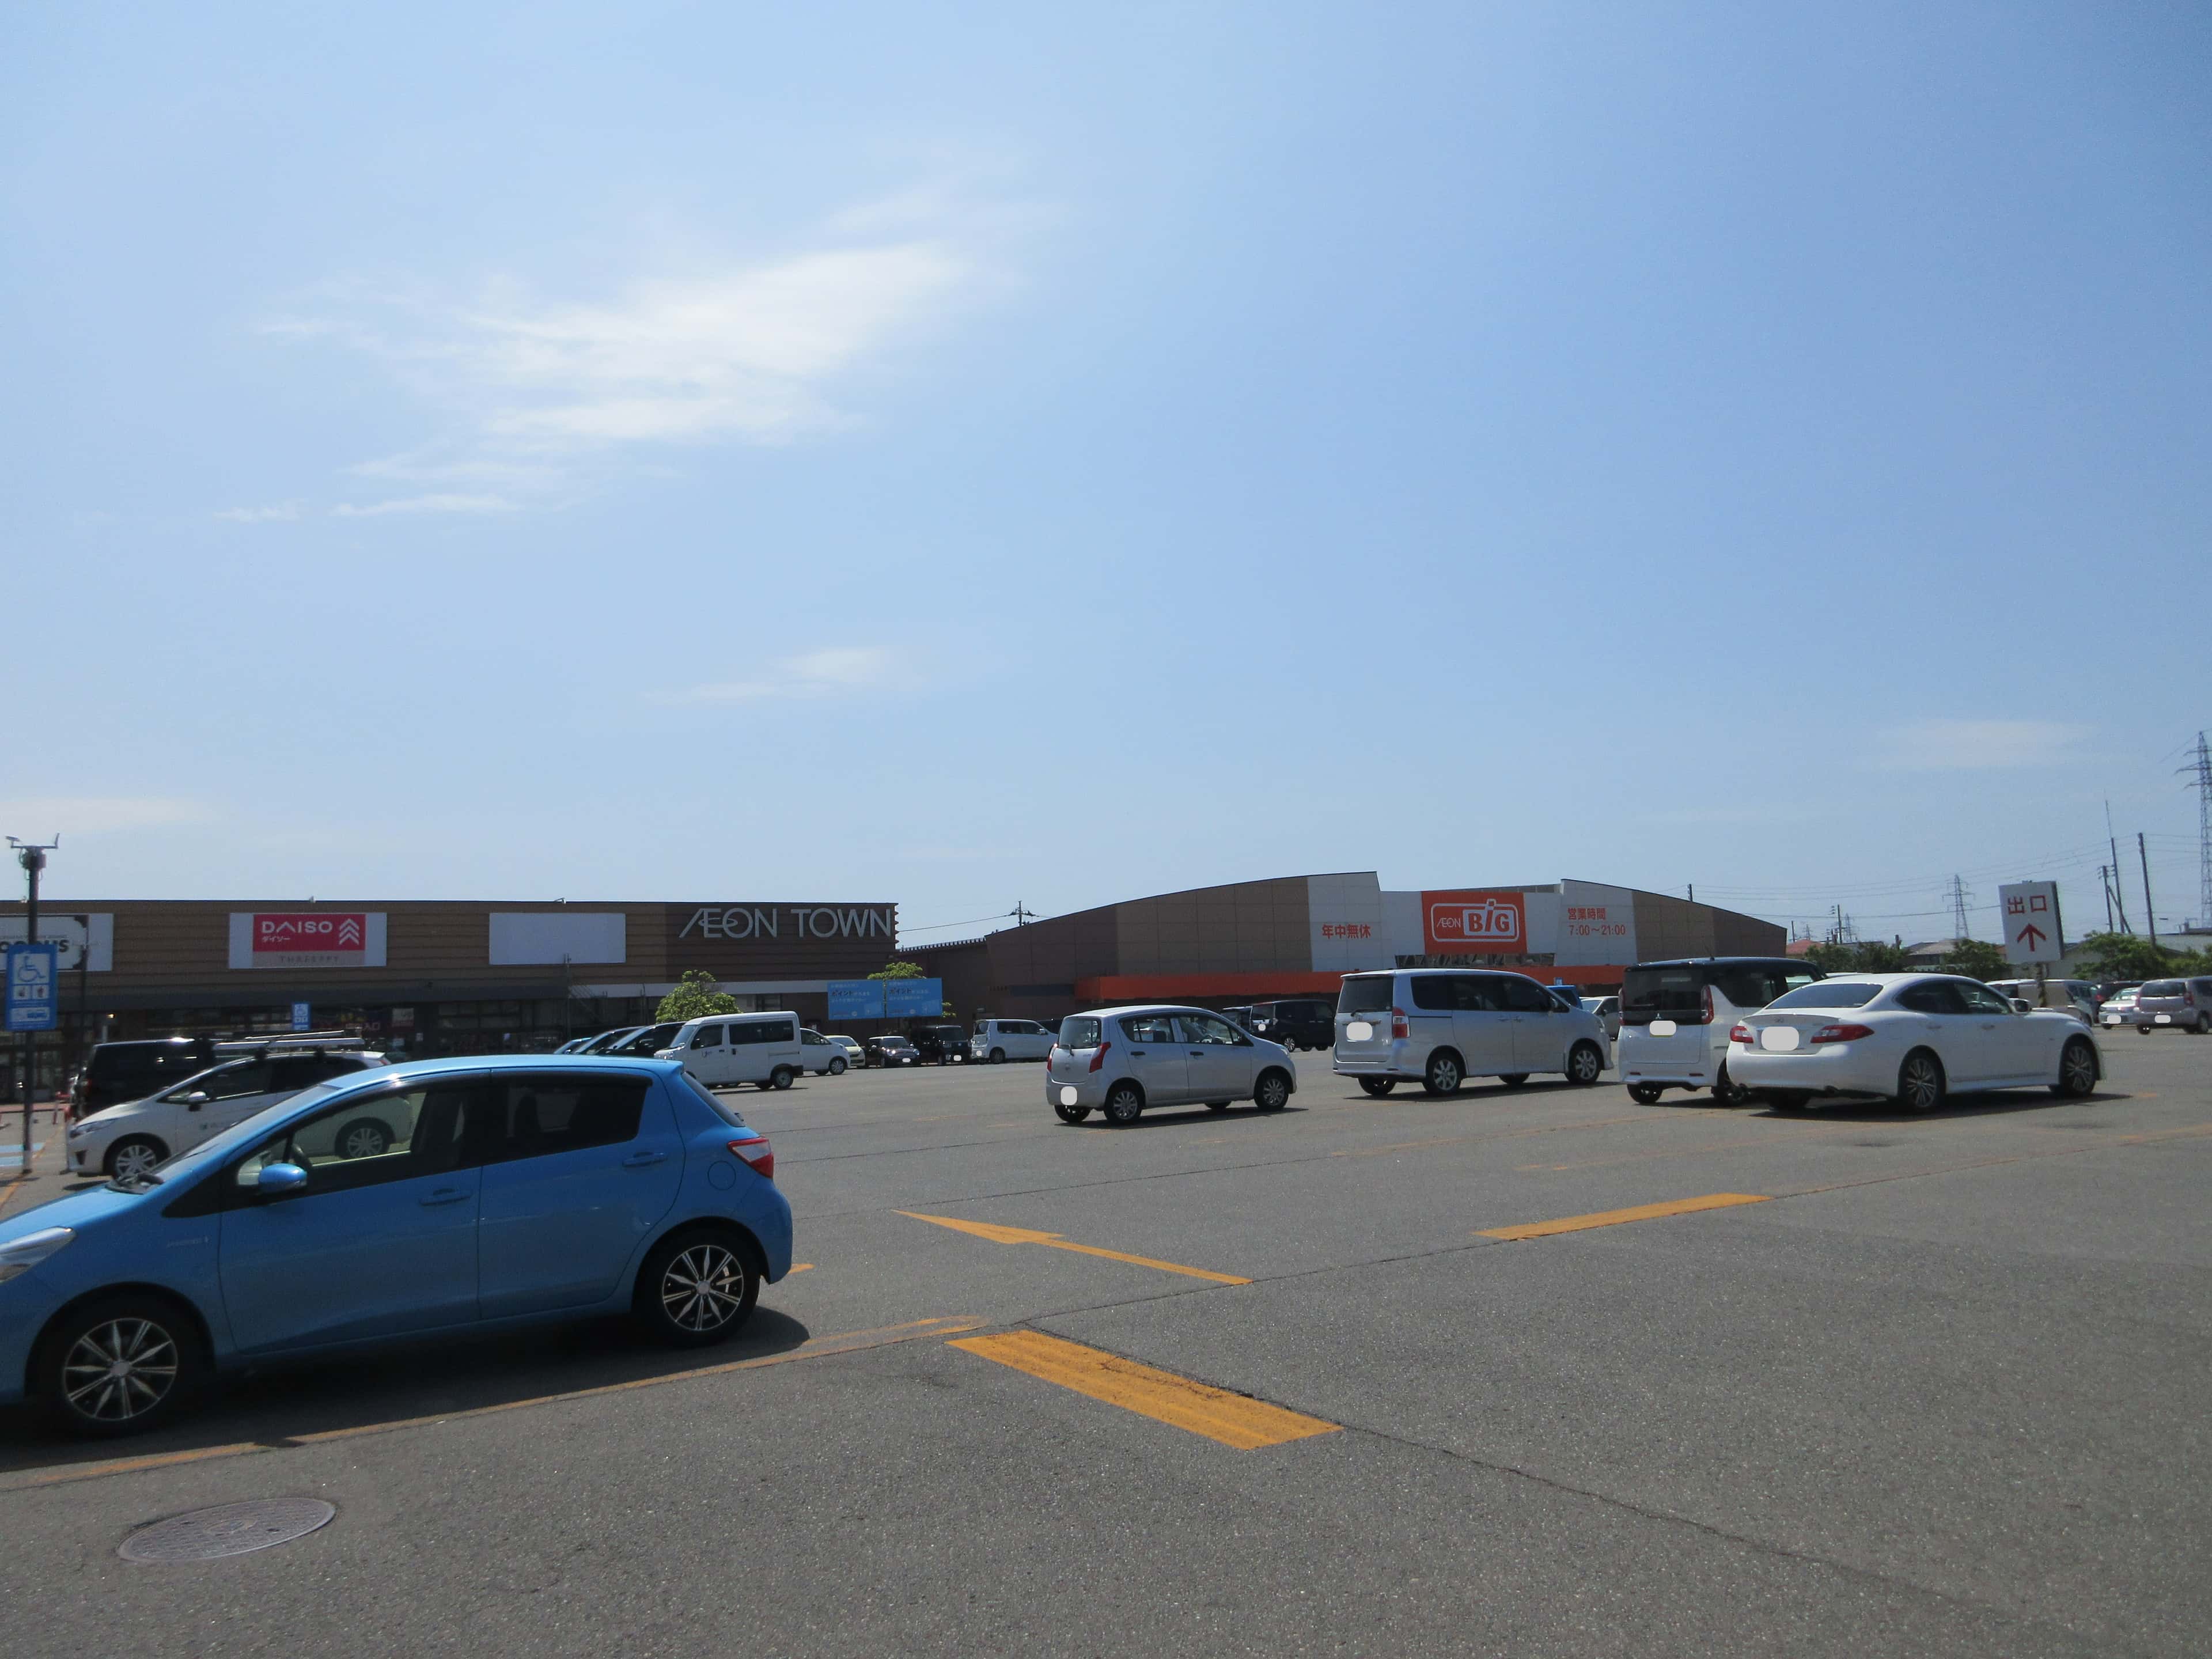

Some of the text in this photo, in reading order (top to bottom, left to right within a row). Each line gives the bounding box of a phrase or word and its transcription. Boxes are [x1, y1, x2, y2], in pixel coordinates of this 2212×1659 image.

[2008, 895, 2047, 915] 出口
[1568, 907, 1606, 920] 営業時間
[262, 921, 333, 934] DAISO
[790, 908, 891, 938] TOWN
[1322, 924, 1371, 940] 年中無休
